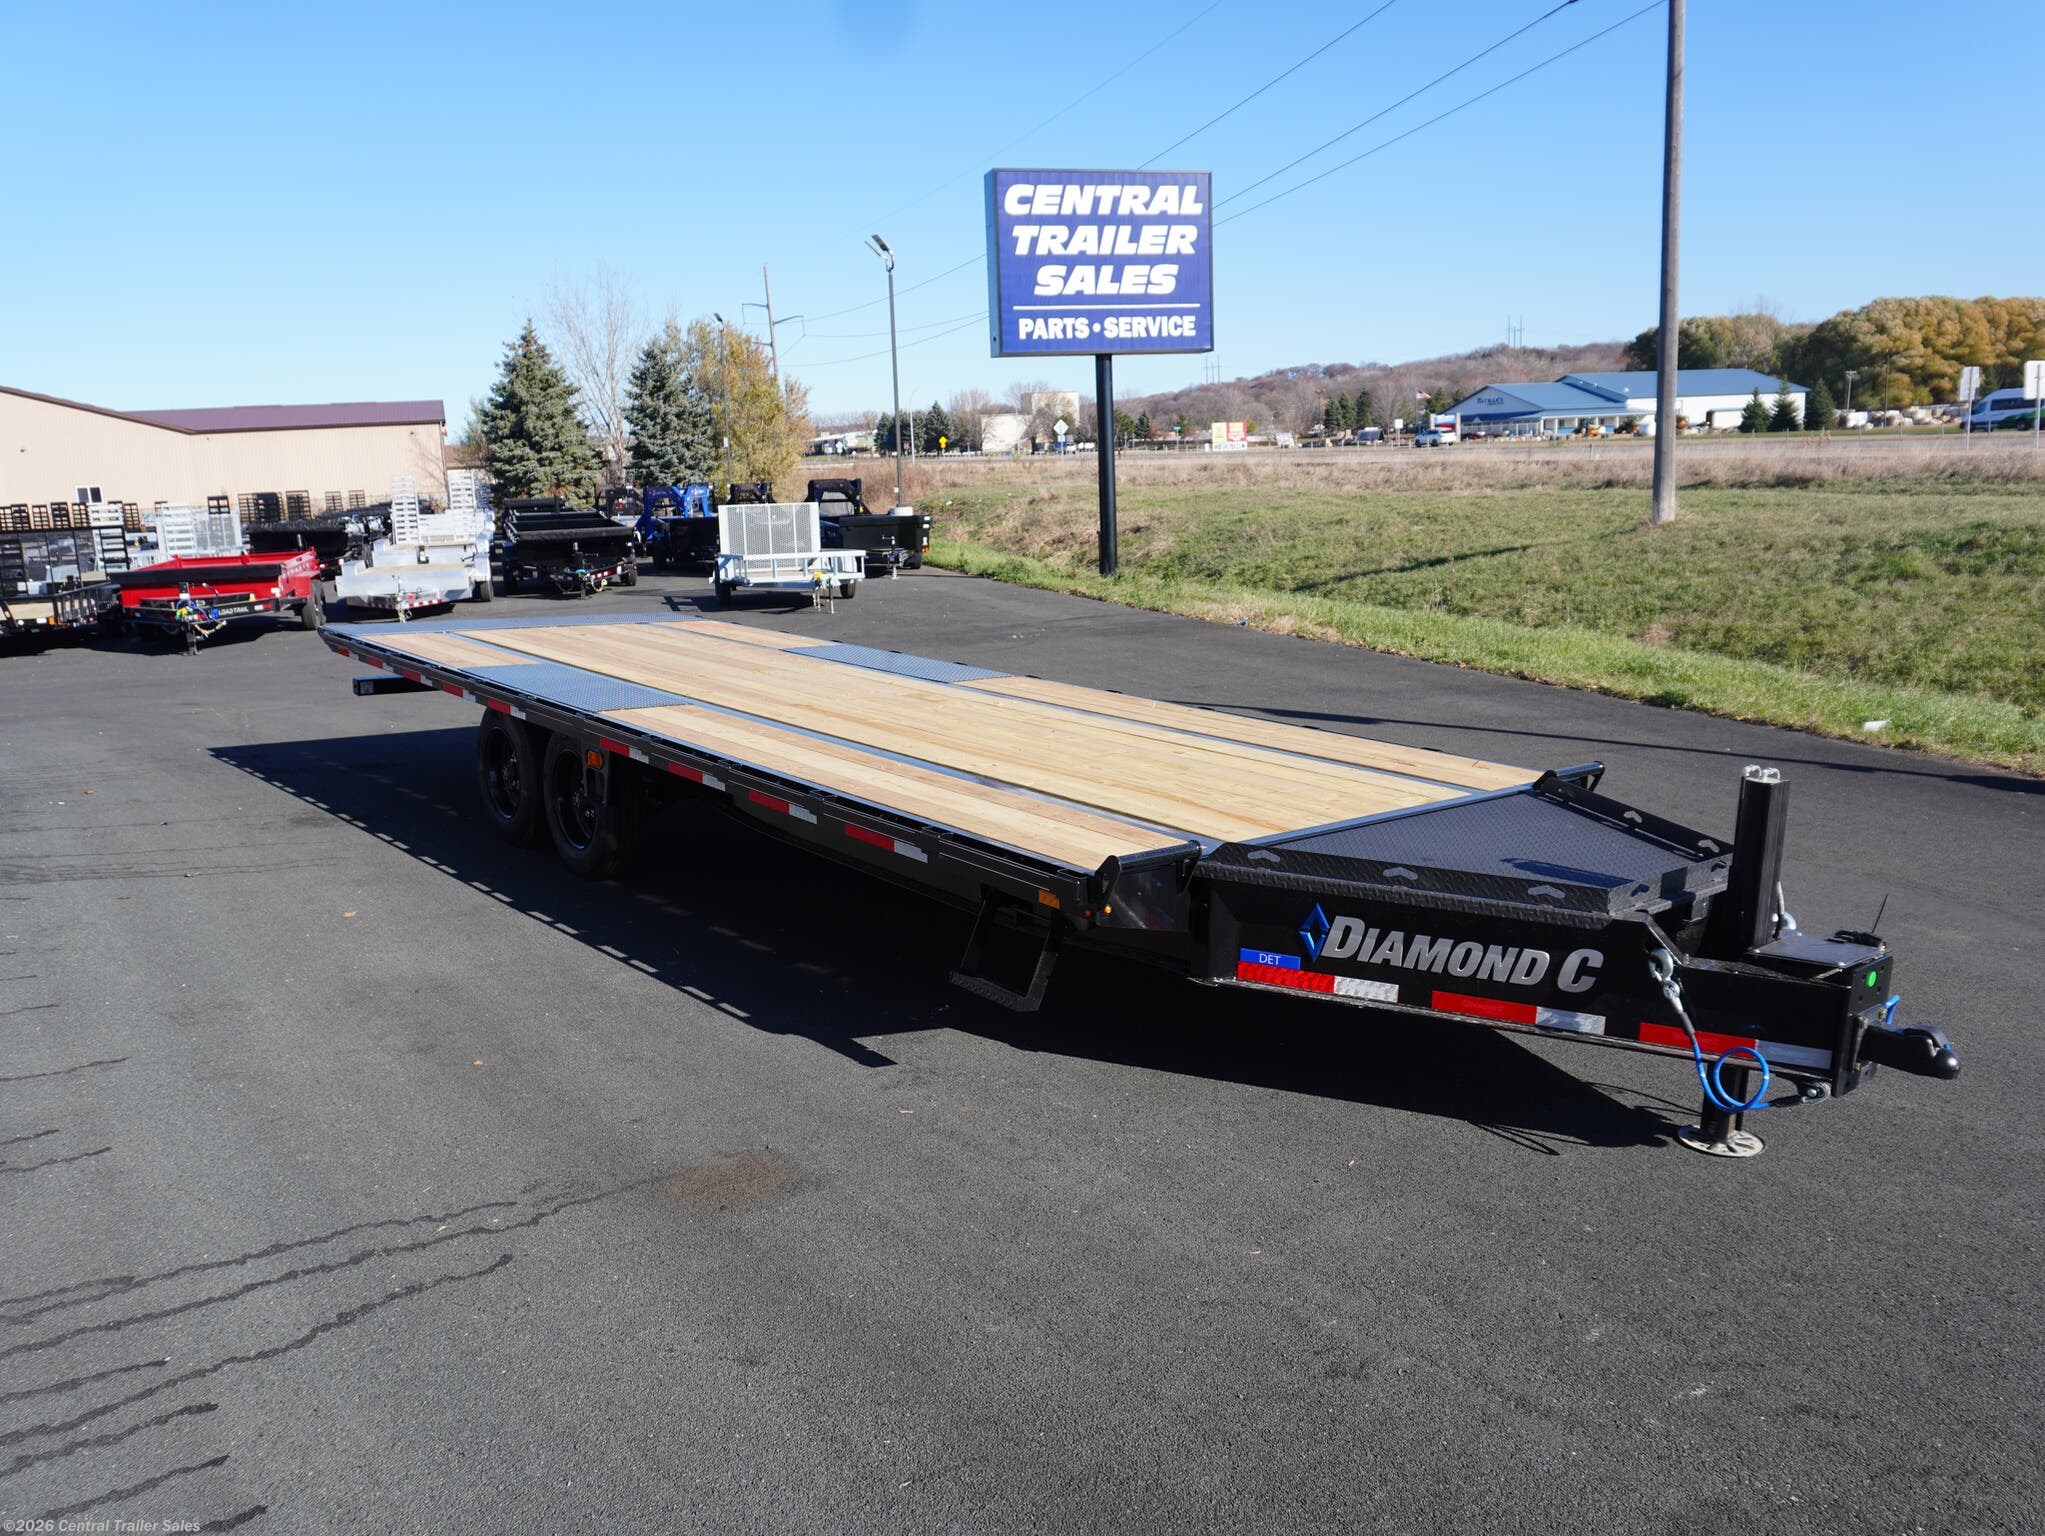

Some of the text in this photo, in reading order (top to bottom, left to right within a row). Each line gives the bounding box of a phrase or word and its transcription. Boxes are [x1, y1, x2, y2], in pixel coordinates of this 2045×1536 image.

[1004, 184, 1203, 216] CENTRAL
[1012, 225, 1198, 255] TRAILER
[1033, 264, 1180, 296] SALES
[1018, 315, 1196, 340] PARTS SERVICE
[1258, 953, 1281, 966] DET
[1320, 915, 1604, 993] DIAMOND C
